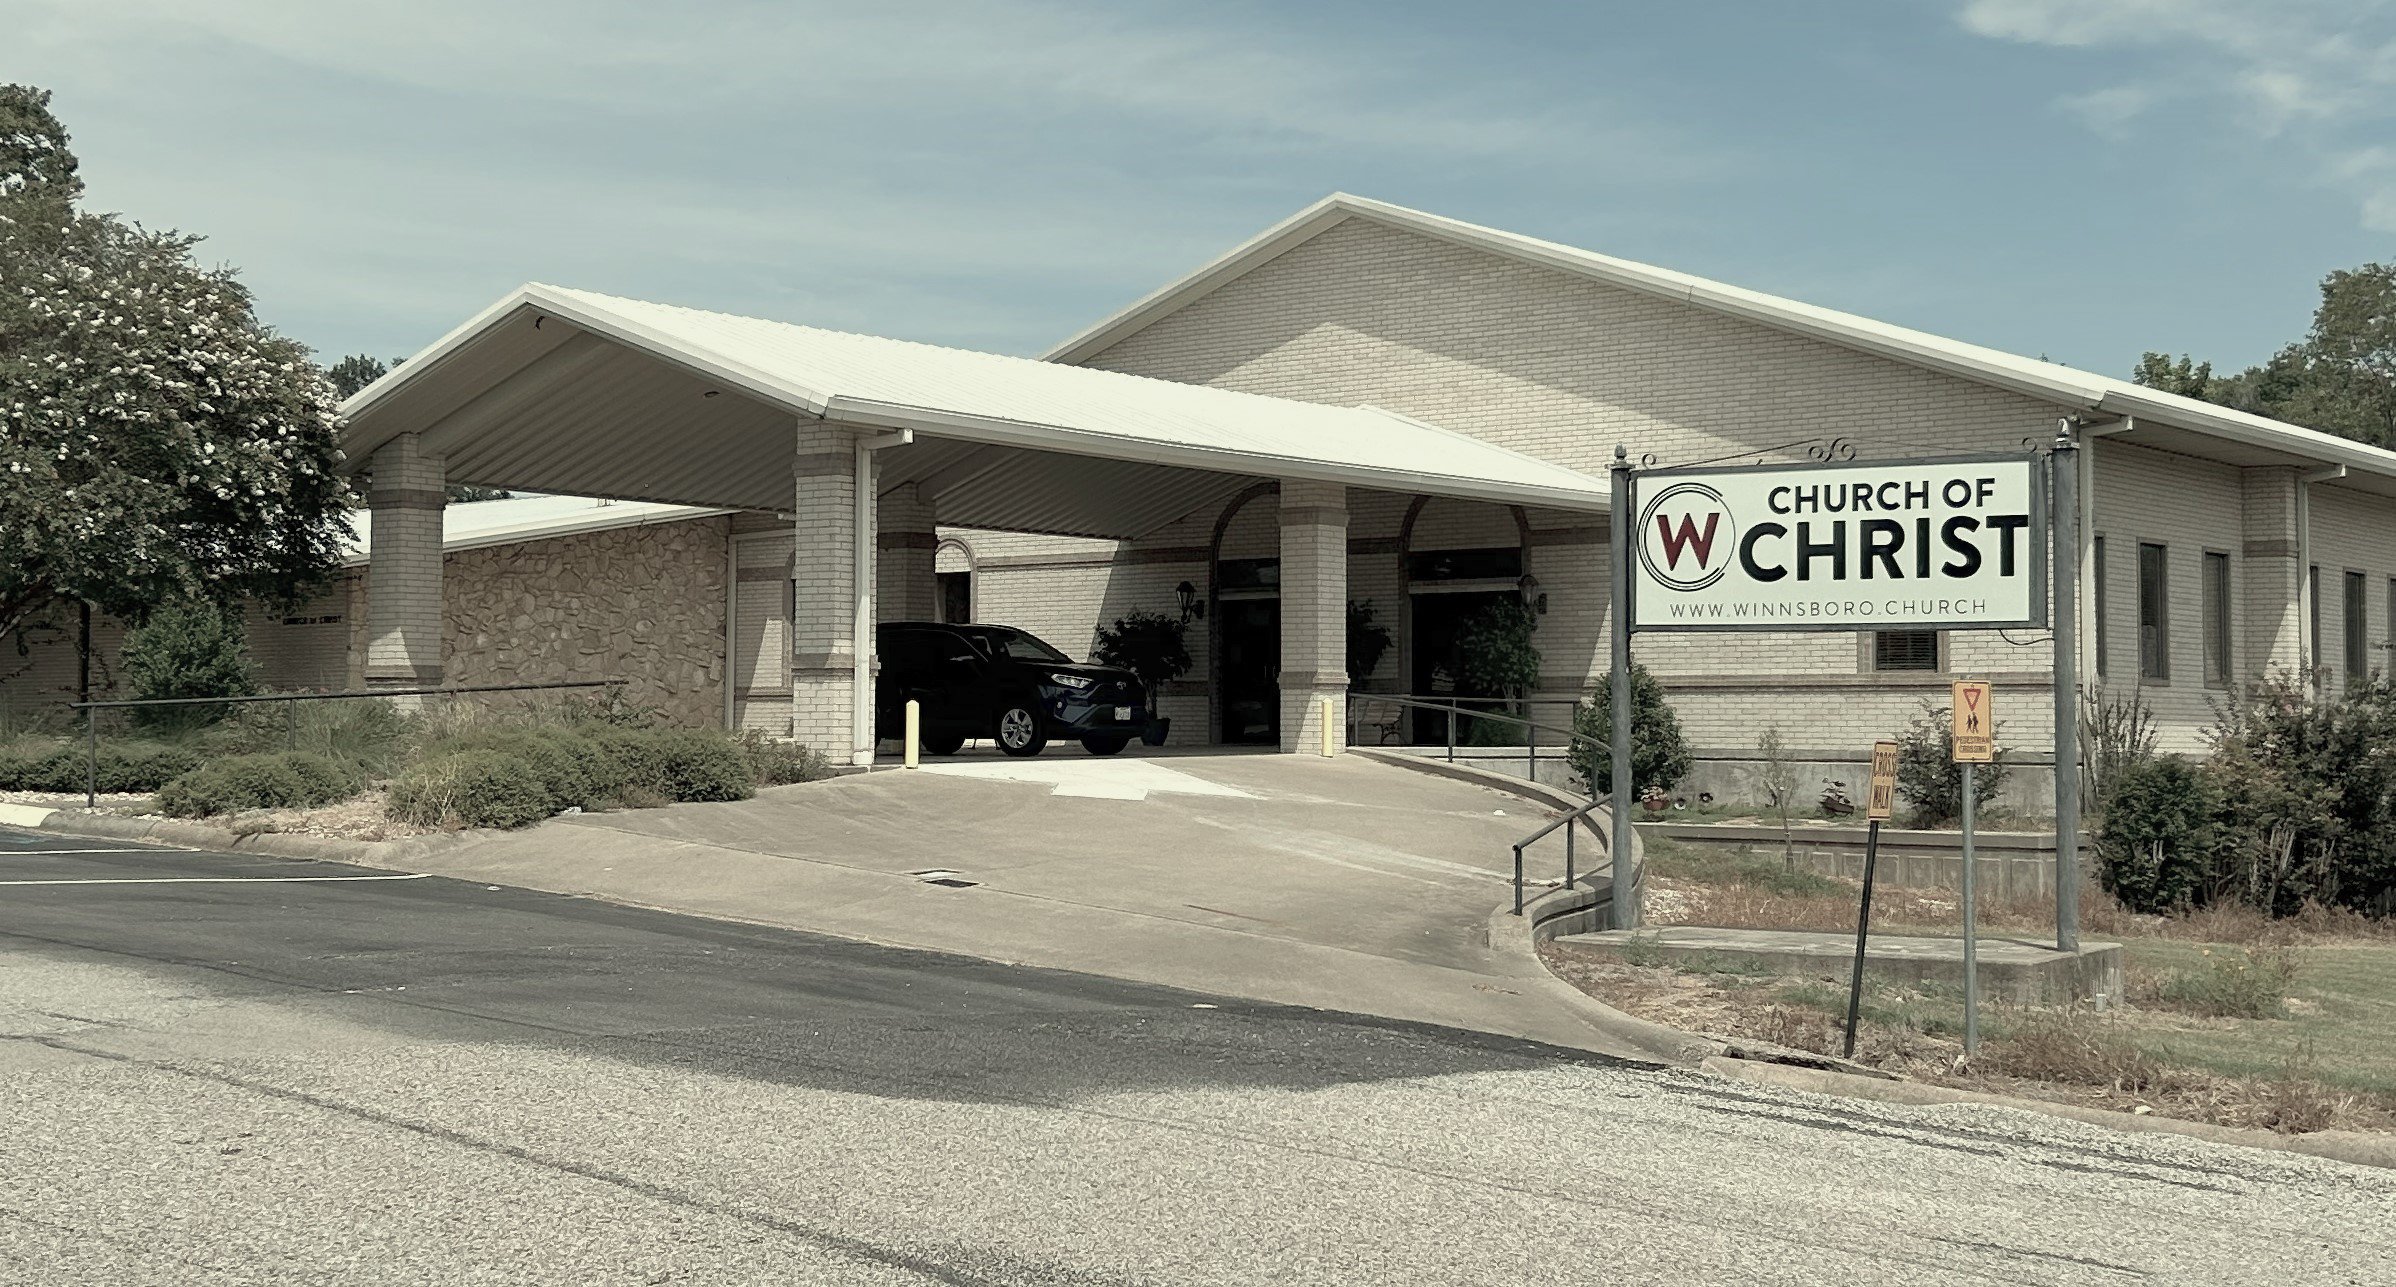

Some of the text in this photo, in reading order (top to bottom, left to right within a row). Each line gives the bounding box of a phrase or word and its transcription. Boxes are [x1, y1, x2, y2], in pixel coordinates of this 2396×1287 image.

[1767, 477, 1995, 514] CHURCH OF
[1656, 512, 1720, 571] W
[1739, 514, 2029, 582] CHRIST
[1670, 598, 1986, 617] WWW.WINNSBORO.CHURCH
[1873, 752, 1897, 777] CROSS
[1872, 785, 1890, 809] WALK
